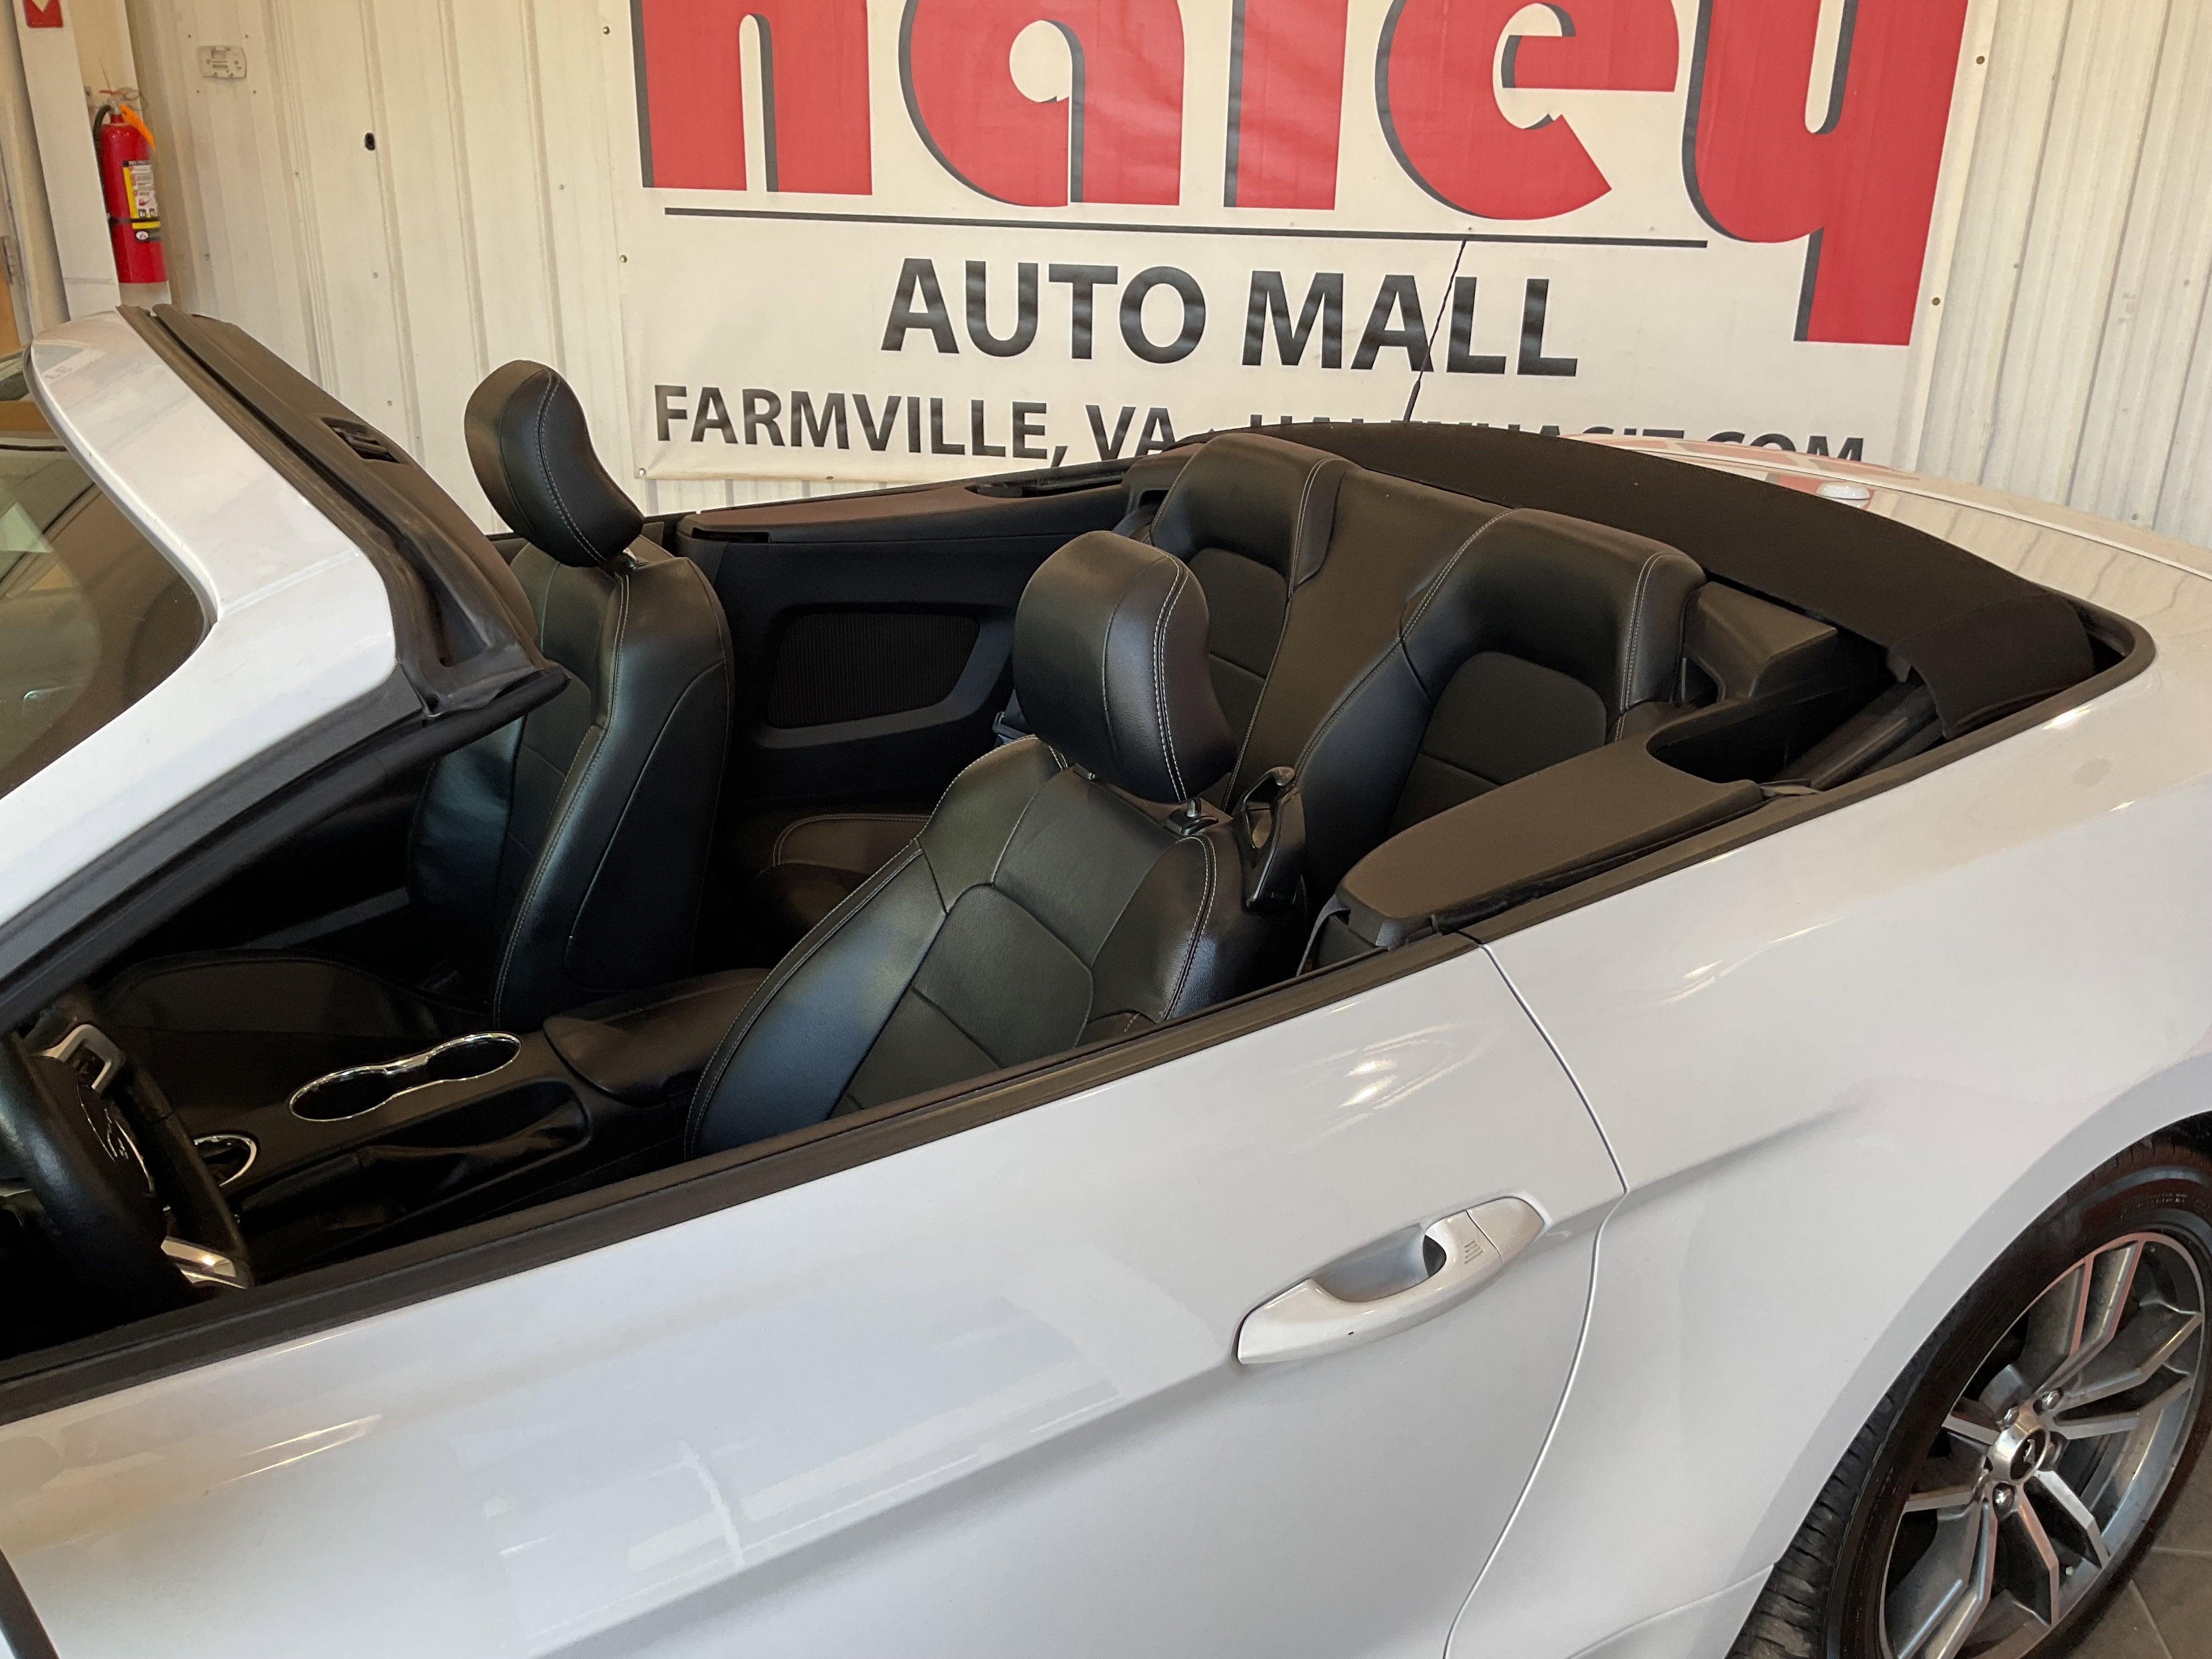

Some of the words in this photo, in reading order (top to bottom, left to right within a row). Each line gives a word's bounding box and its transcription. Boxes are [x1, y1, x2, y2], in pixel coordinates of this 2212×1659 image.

[881, 258, 1206, 364] AUTO
[1242, 270, 1578, 377] MALL
[654, 385, 1068, 468] FARMVILLE,
[1085, 404, 1176, 461] VA
